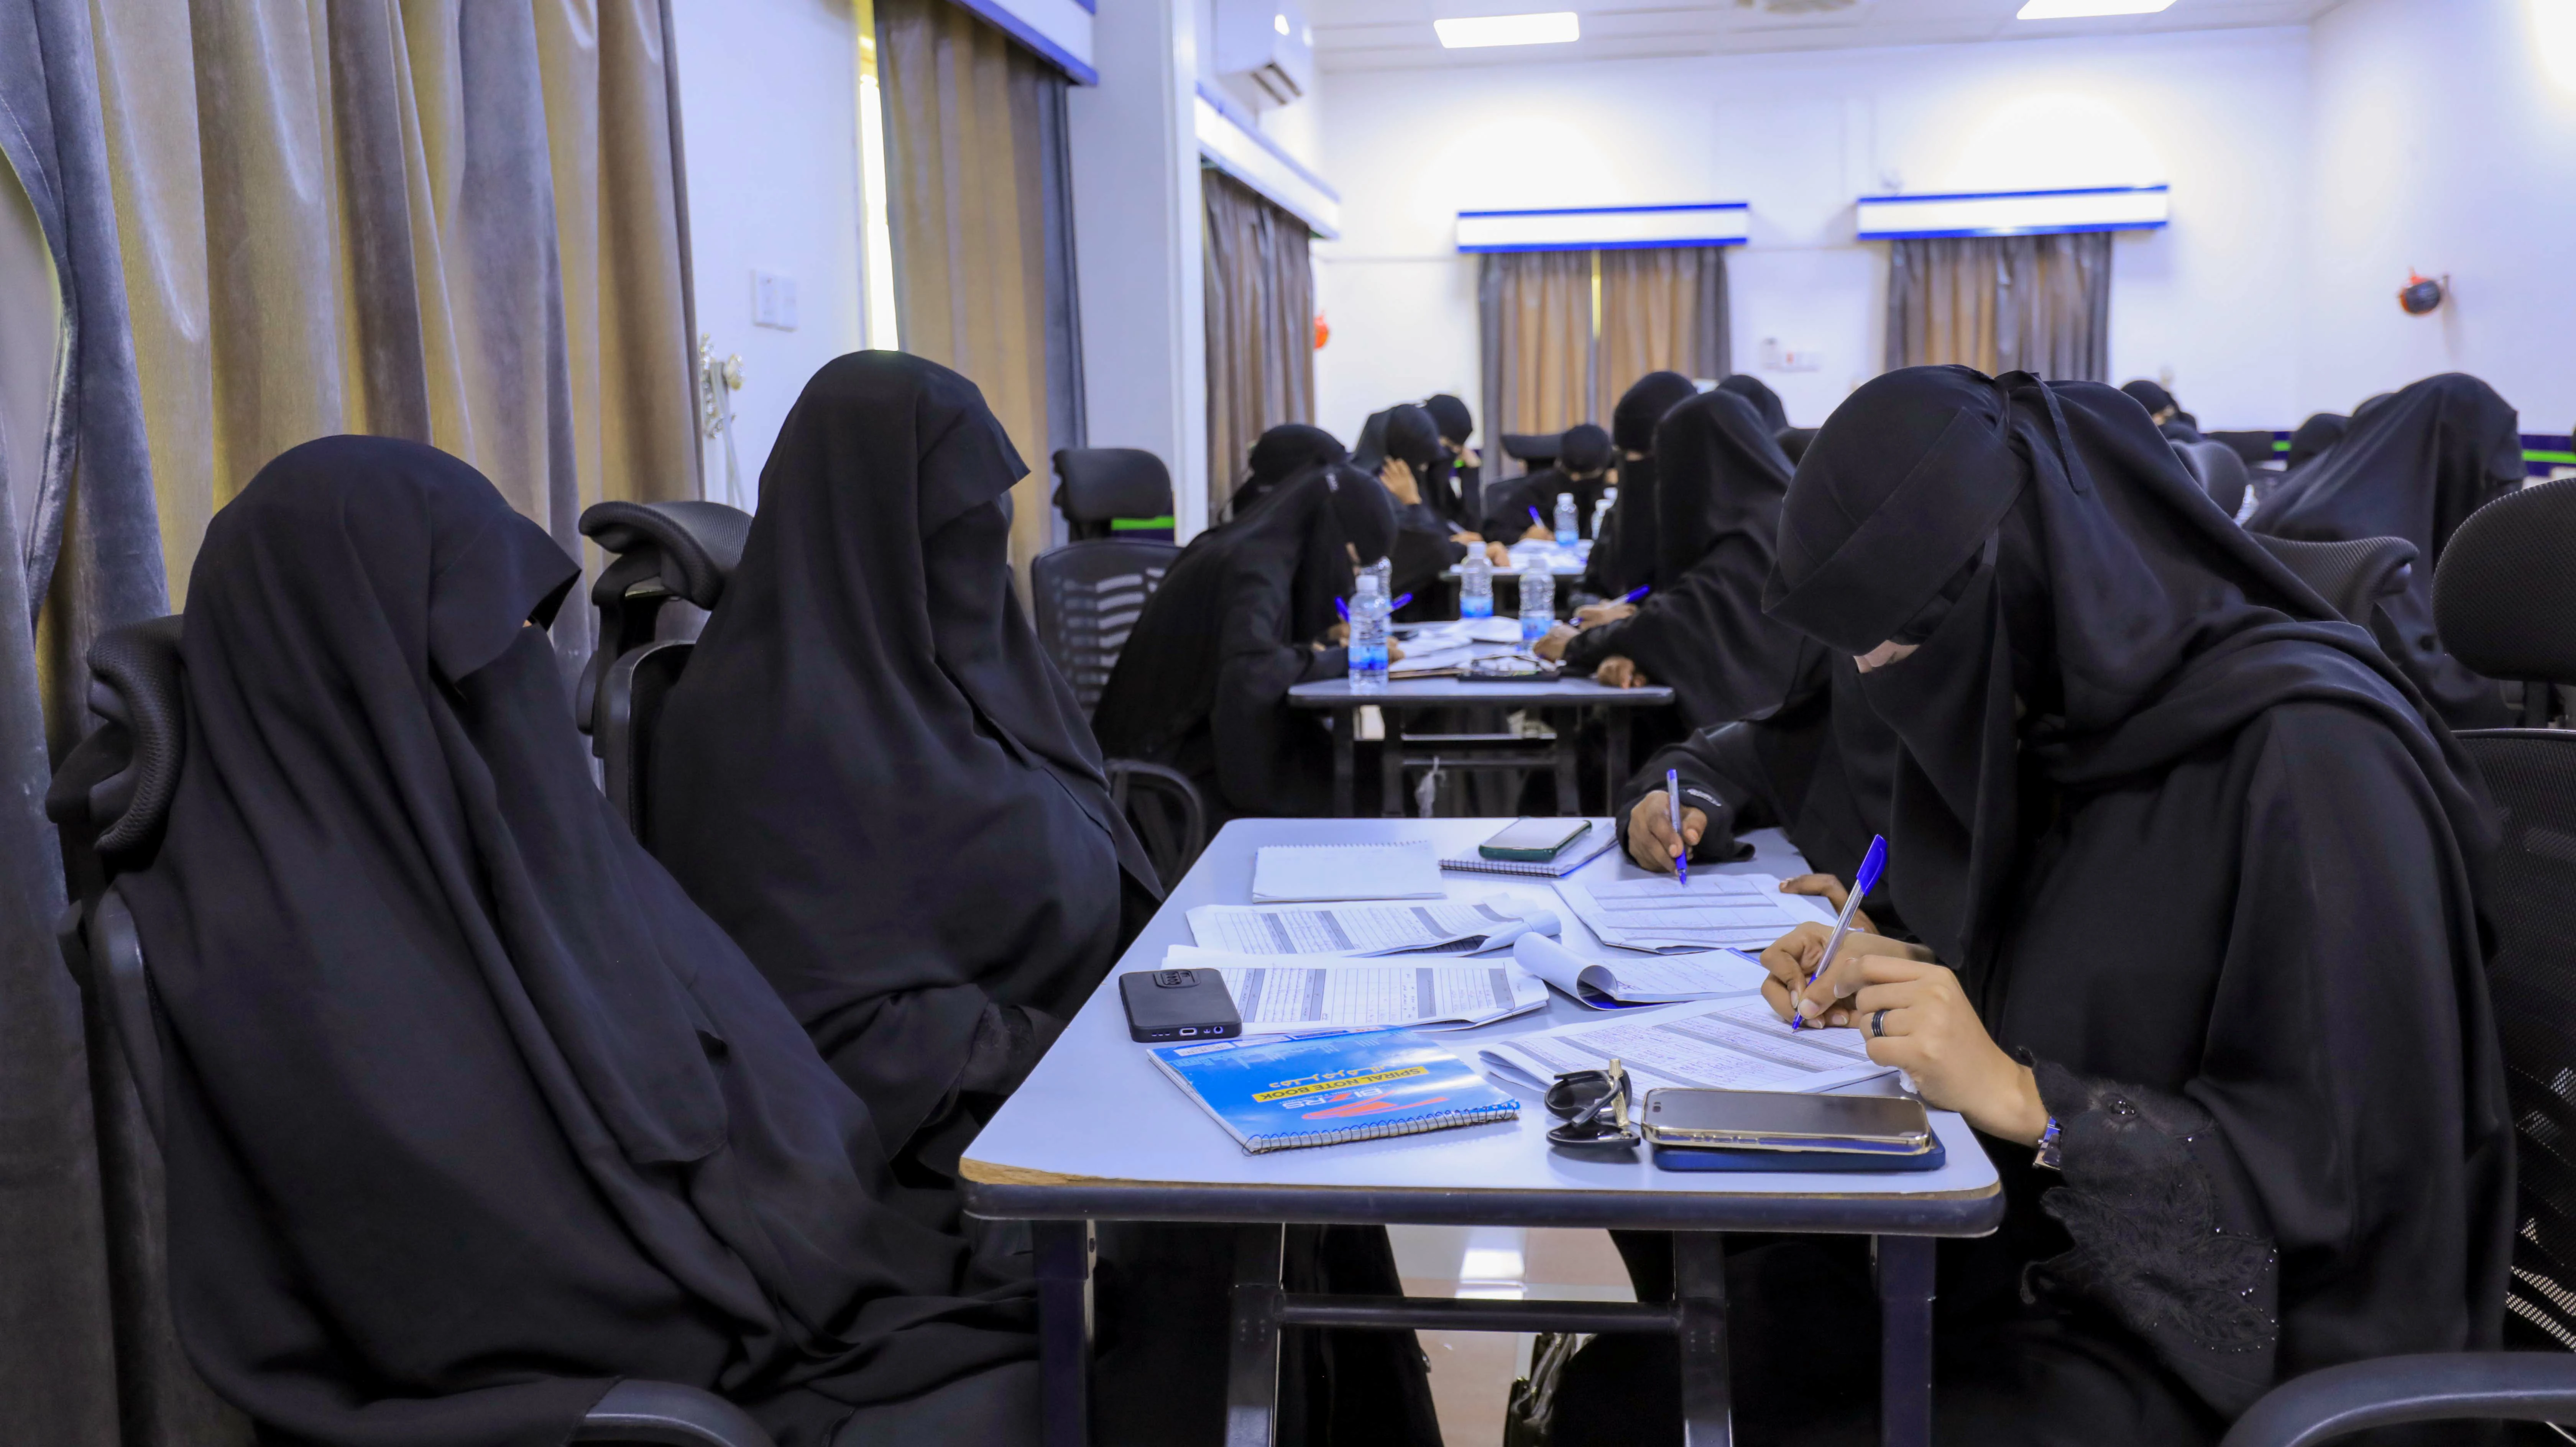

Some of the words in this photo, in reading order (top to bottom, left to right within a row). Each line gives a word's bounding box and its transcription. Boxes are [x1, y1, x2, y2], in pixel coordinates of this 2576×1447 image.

[1361, 1068, 1421, 1083] SPIRAL
[1314, 1079, 1360, 1092] NOTE
[1260, 1086, 1310, 1100] BOOK
